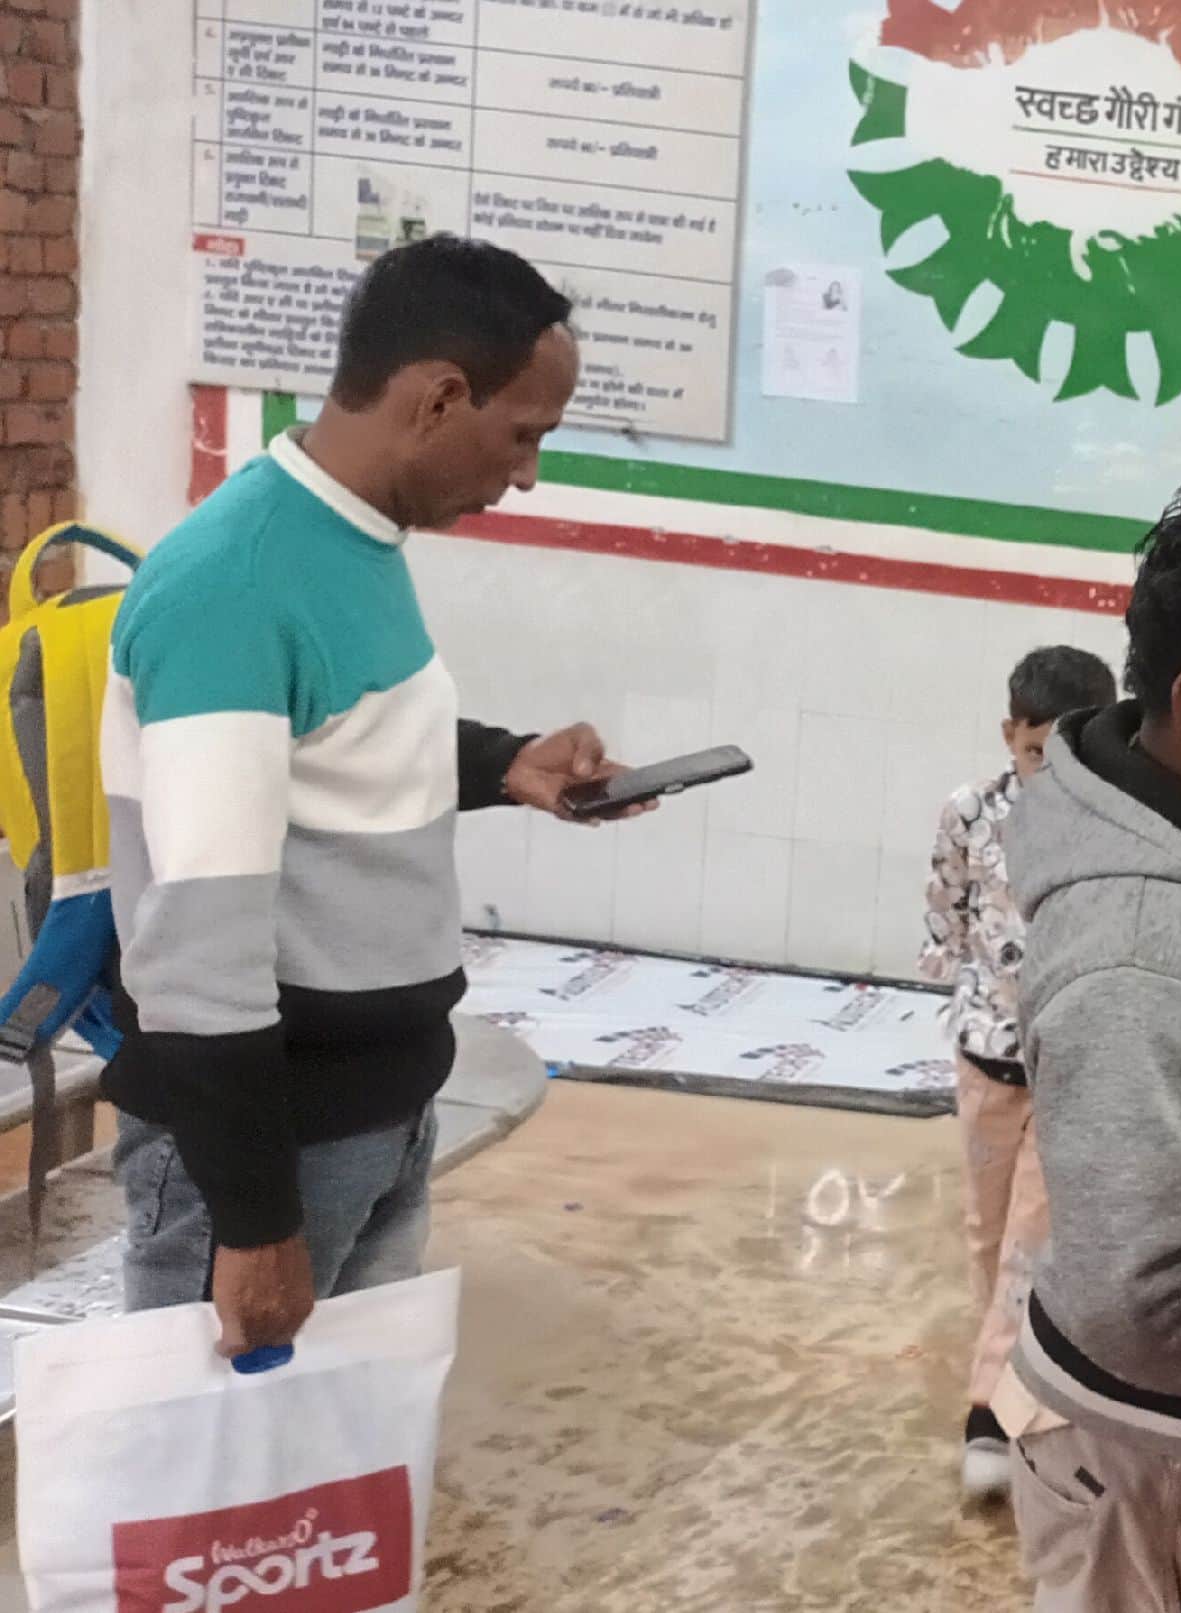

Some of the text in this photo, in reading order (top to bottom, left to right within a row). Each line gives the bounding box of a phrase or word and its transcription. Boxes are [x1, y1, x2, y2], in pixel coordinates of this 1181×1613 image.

[1015, 86, 1100, 125] स्वच्छ
[1111, 147, 1181, 181] उद्देश्य
[163, 1531, 379, 1612] Sportz
